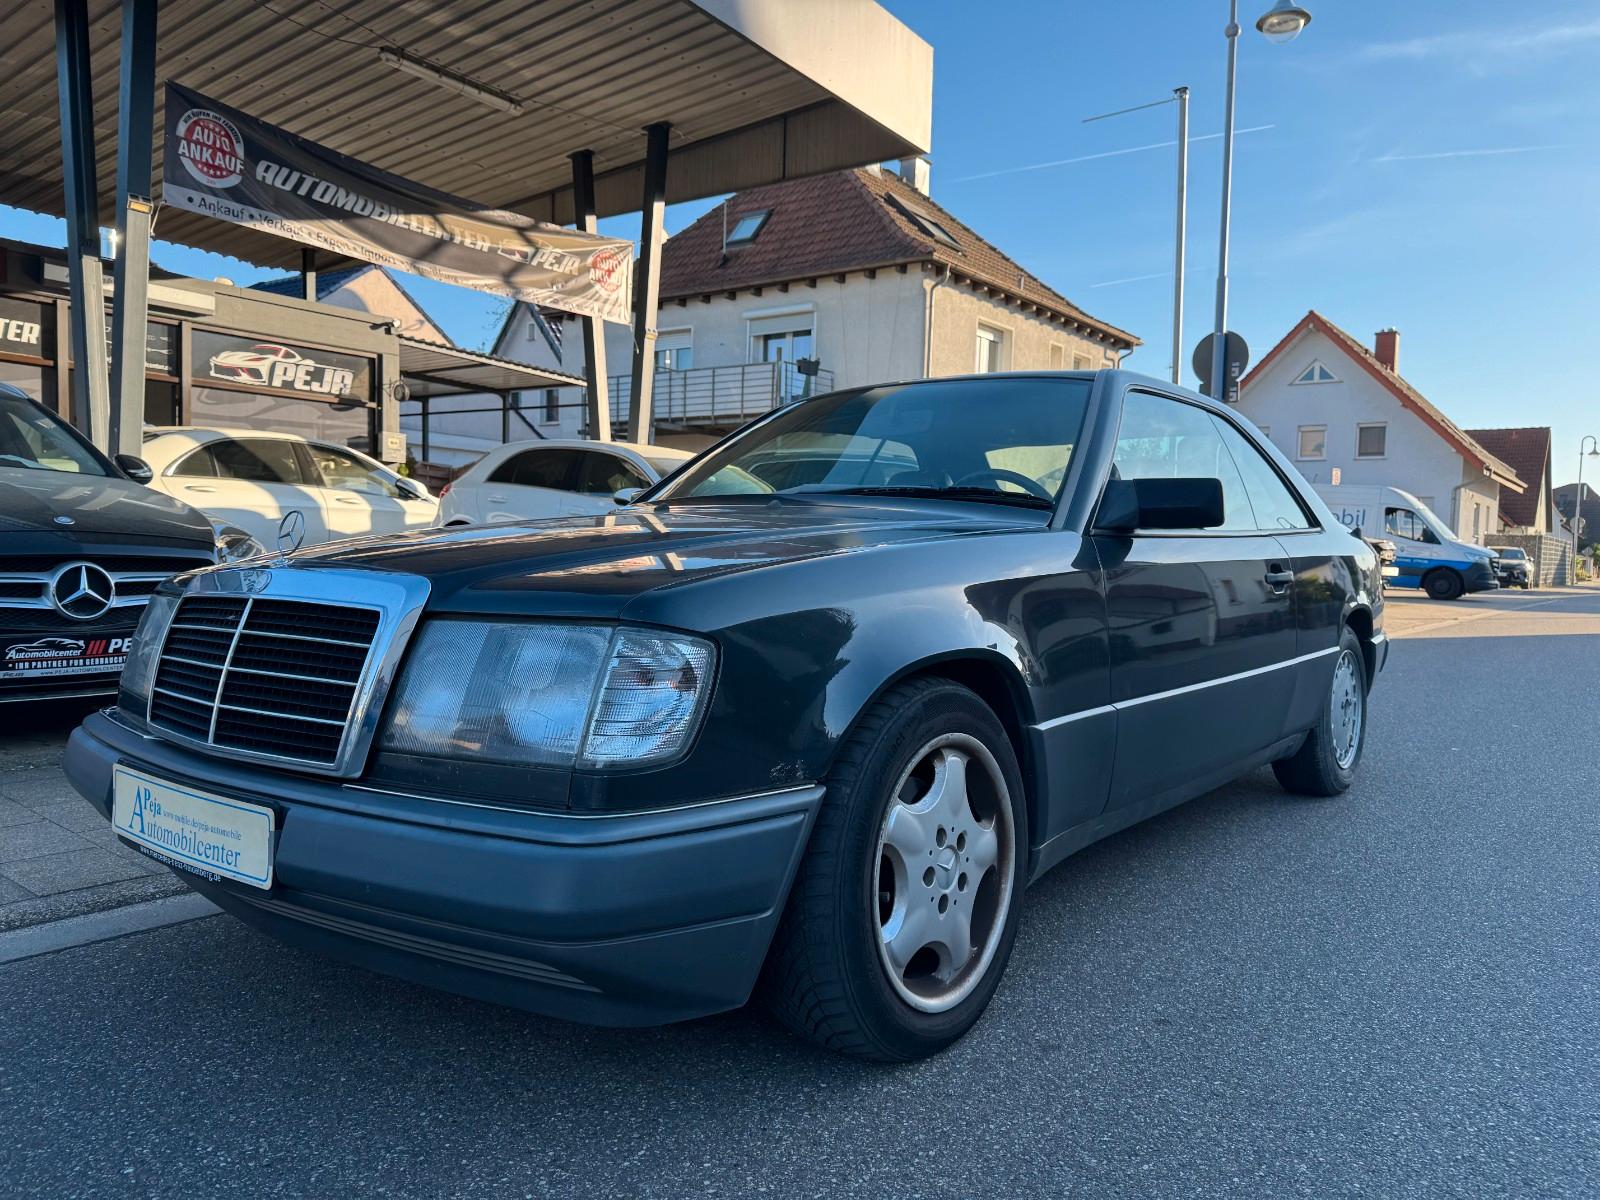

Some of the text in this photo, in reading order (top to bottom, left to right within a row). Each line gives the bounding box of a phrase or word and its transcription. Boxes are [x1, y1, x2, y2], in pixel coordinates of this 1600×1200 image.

[192, 126, 230, 152] AUTO
[178, 139, 245, 175] ANKAUF
[198, 196, 245, 221] Ankauf
[530, 247, 581, 276] PEJA
[271, 361, 354, 395] PEJA
[5, 649, 81, 660] Automobilcenter
[144, 787, 161, 818] Peja
[128, 785, 241, 868] Automobilcenter
